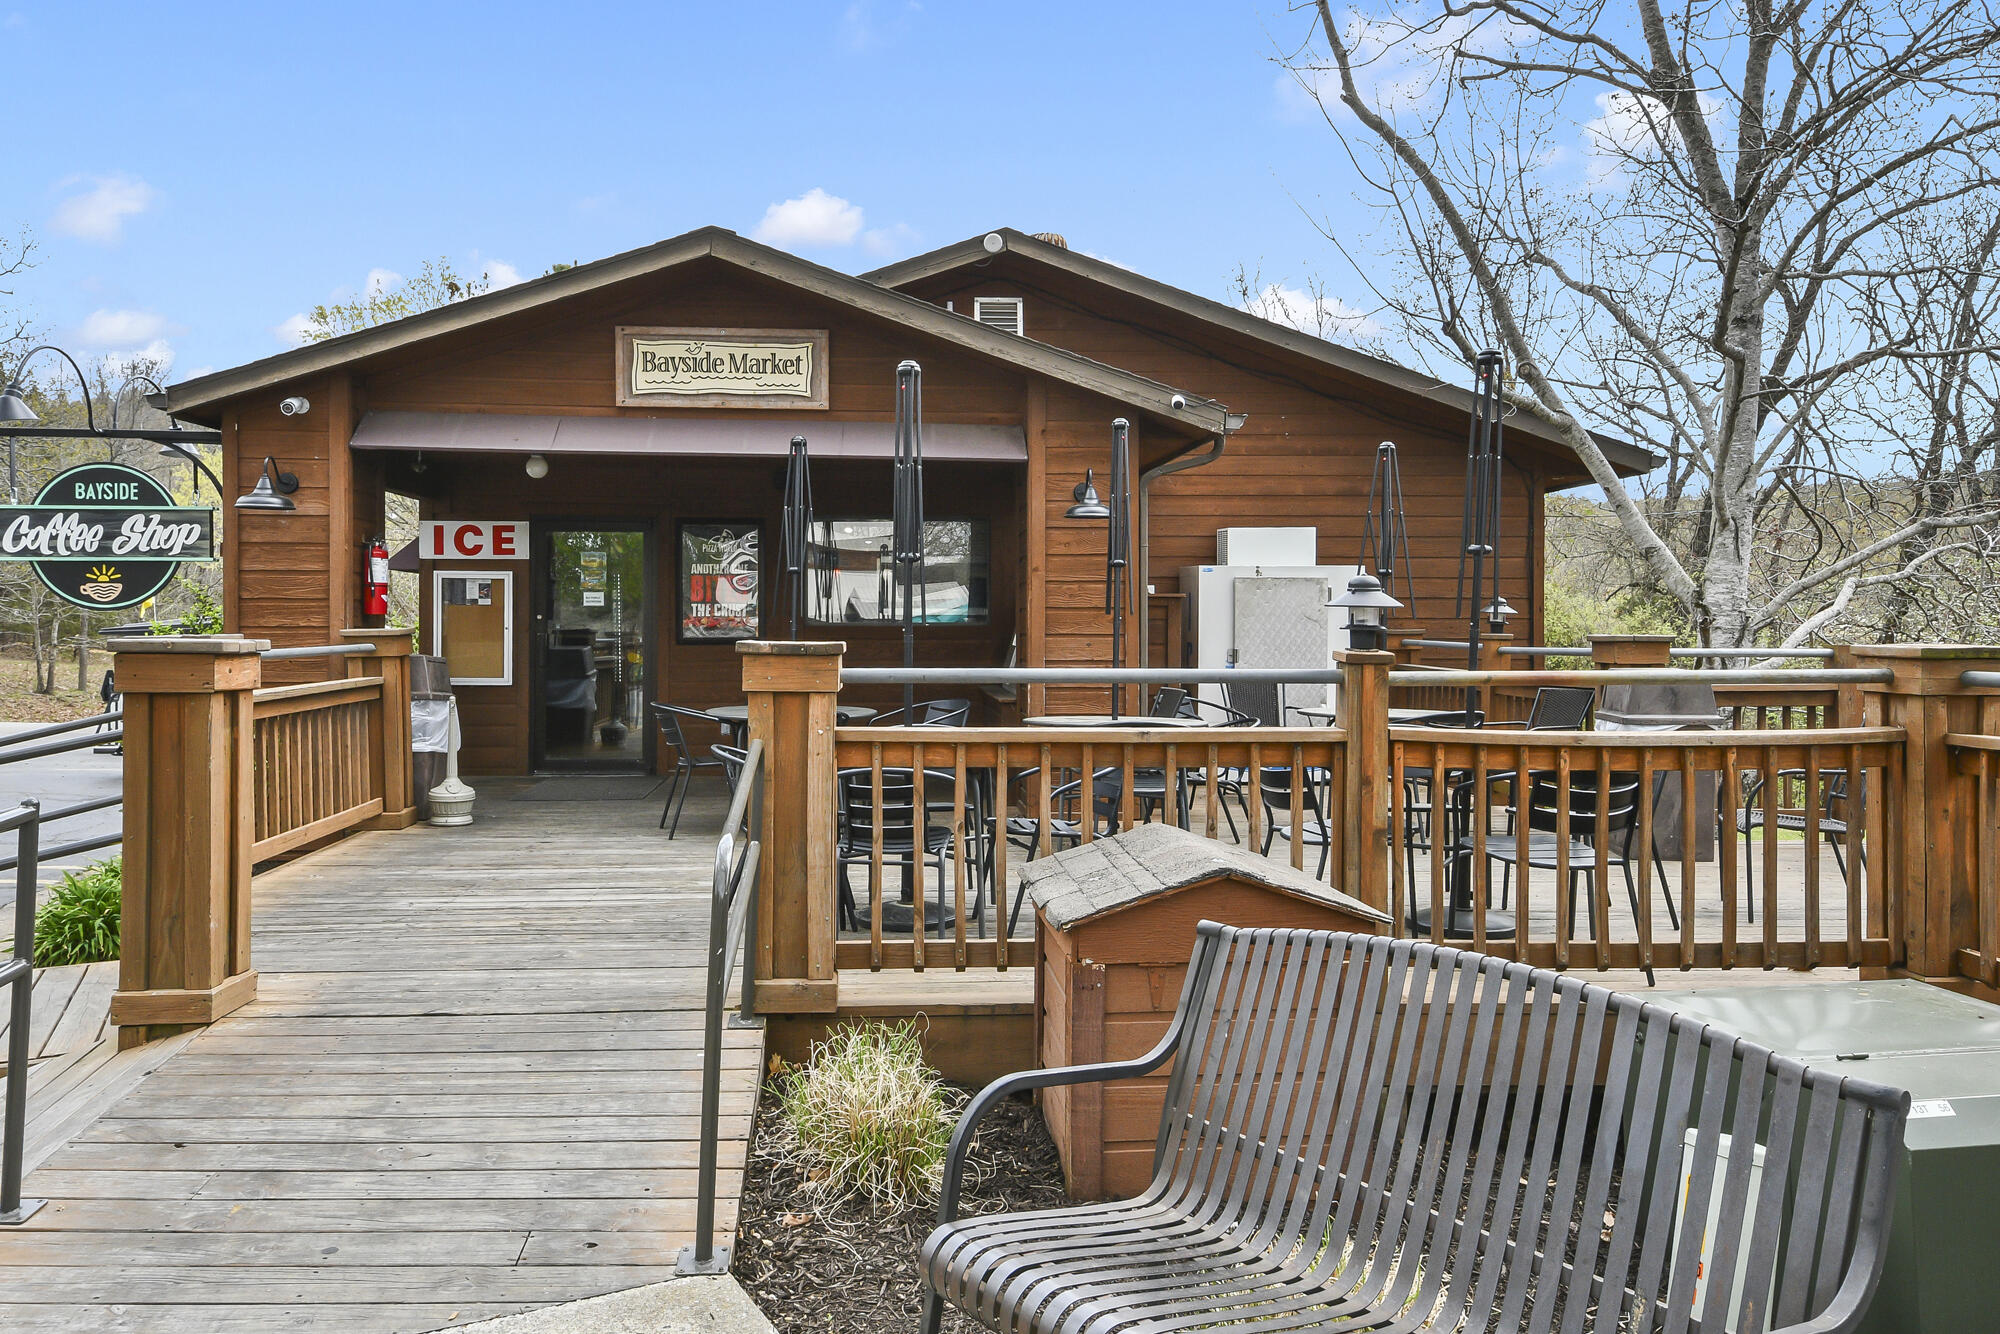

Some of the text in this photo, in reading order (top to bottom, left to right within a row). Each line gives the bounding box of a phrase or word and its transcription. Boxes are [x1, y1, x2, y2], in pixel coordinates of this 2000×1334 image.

[641, 351, 803, 378] Bayside Market
[75, 482, 139, 500] BAYSIDE
[2, 512, 201, 556] Coffee Shop
[433, 524, 516, 556] ICE
[702, 543, 717, 553] PIZZA
[691, 564, 729, 574] ANOTHER
[691, 603, 711, 617] THE
